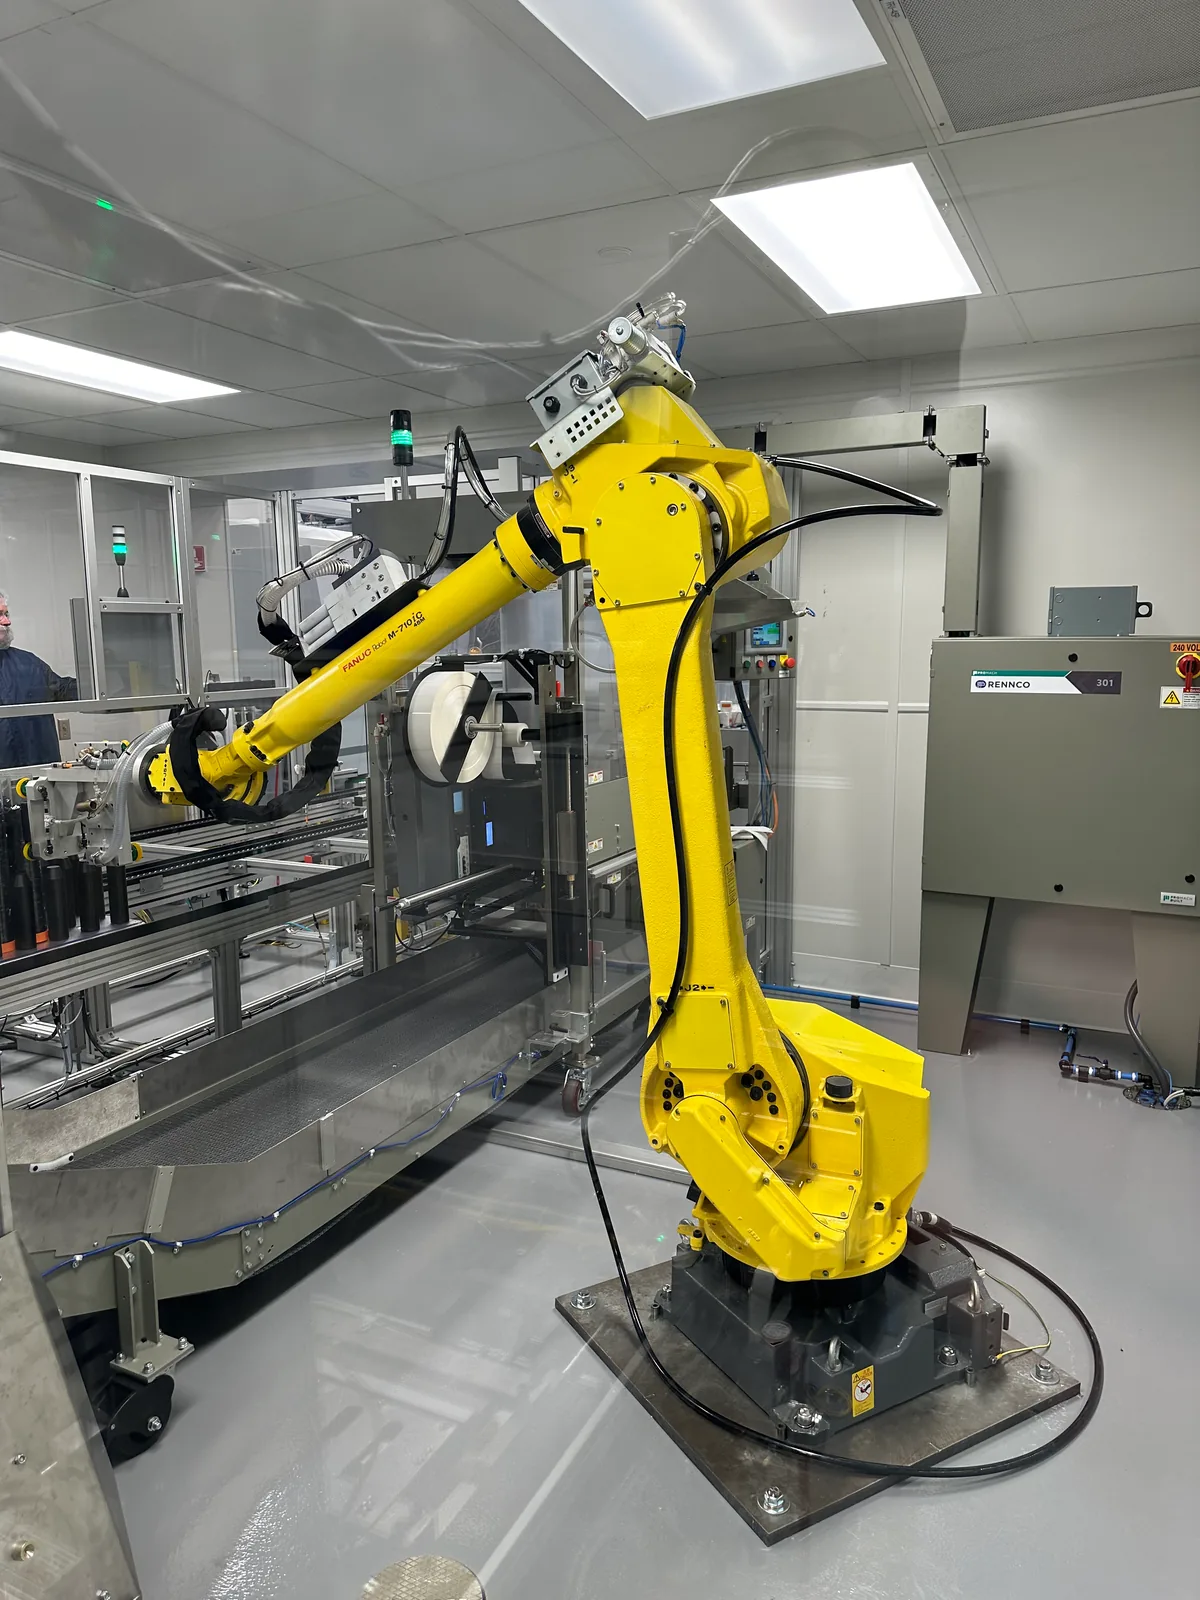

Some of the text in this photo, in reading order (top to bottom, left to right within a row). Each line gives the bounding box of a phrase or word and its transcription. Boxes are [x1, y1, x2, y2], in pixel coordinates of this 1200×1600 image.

[1173, 644, 1185, 652] 240
[342, 648, 372, 673] FANUC
[371, 638, 388, 652] Robot
[988, 681, 1031, 689] RENNCO
[1096, 679, 1114, 687] 301
[684, 984, 701, 992] J2
